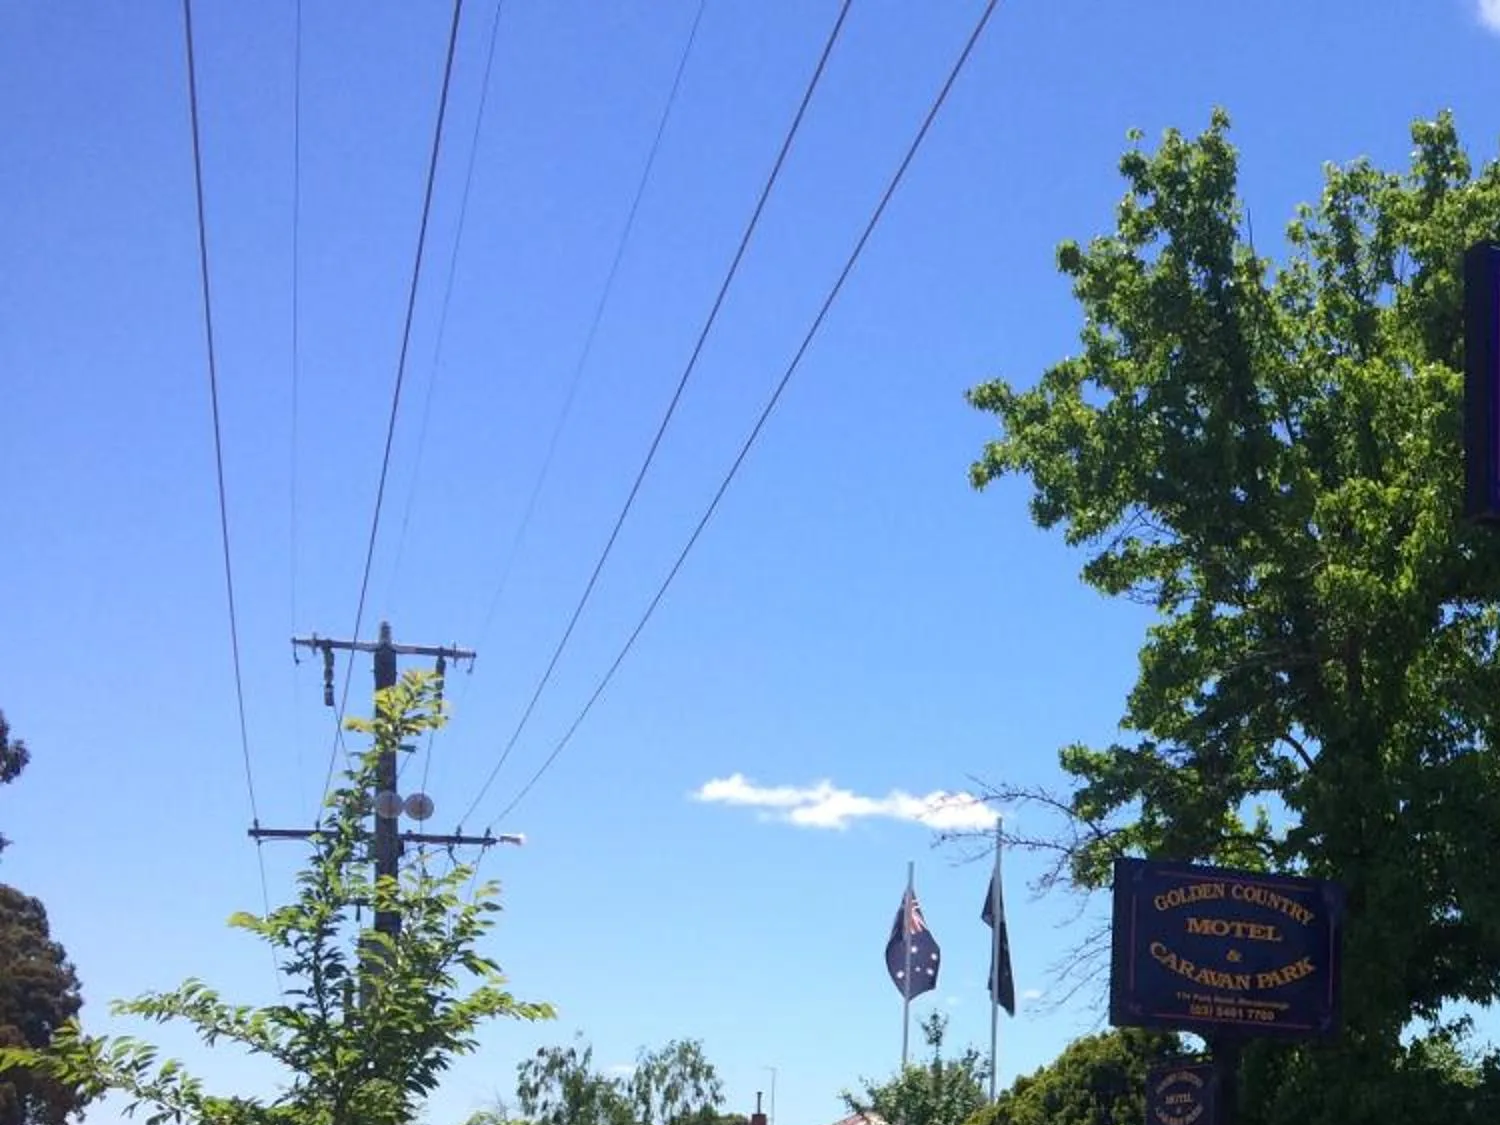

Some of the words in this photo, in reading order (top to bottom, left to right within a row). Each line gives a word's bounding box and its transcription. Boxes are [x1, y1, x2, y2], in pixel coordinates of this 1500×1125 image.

[1154, 883, 1225, 911] GOLDEN
[1231, 883, 1314, 925] COUNTRY
[1187, 917, 1282, 942] MOTEL
[1150, 941, 1251, 990] CARAVAN
[1257, 956, 1317, 989] PARK
[1226, 949, 1241, 962] &
